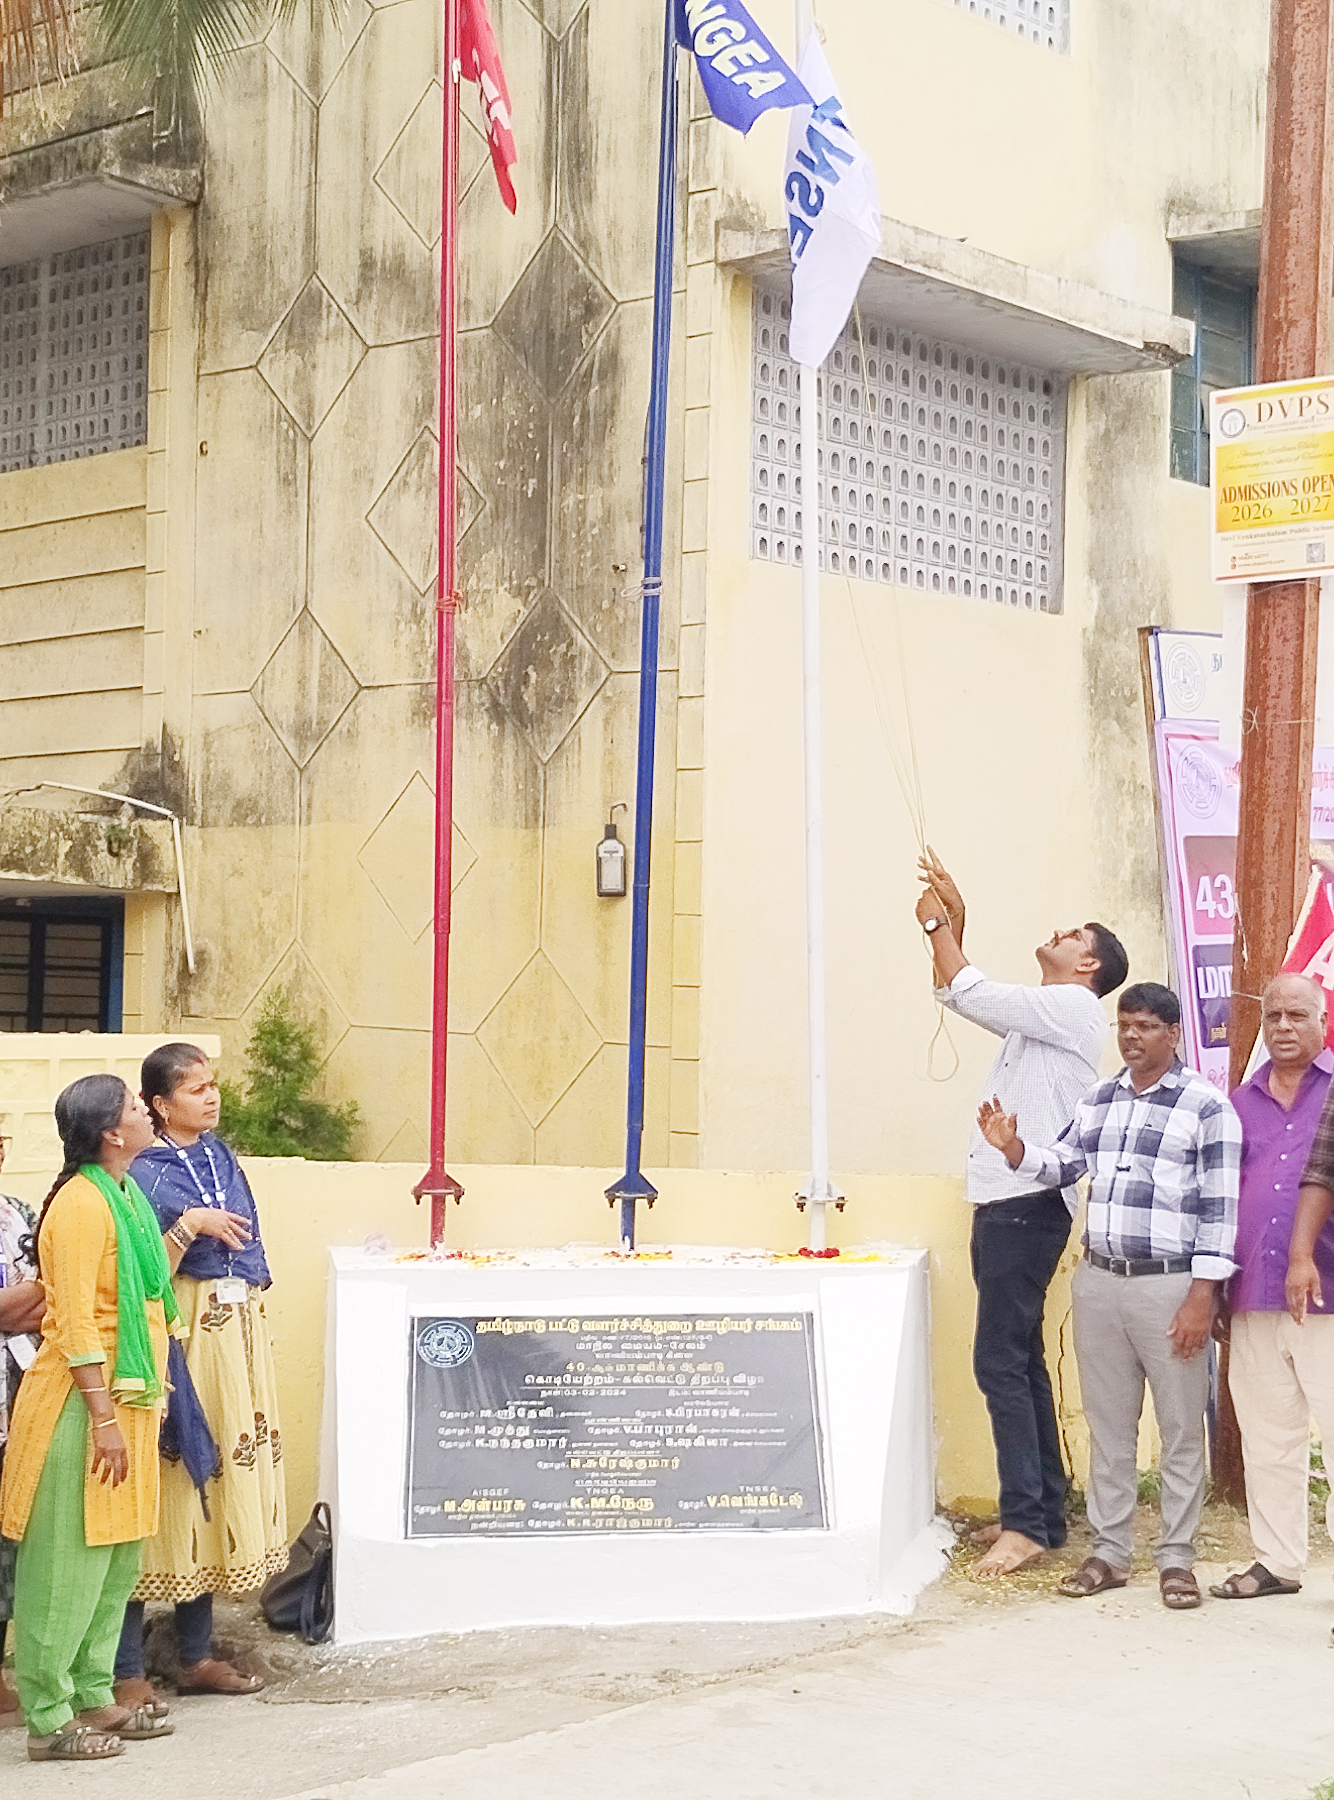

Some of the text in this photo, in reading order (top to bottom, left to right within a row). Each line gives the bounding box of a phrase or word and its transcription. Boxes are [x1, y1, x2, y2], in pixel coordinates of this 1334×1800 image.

[1257, 393, 1330, 423] DVPS
[1219, 478, 1298, 504] ADMISSIONS
[1231, 495, 1332, 522] 2026 2027
[476, 1316, 803, 1335] தமிழ்நாடு பட்டு வளர்ச்சித்துறை ஊழியர் சங்கம்
[575, 1341, 613, 1352] மாநில
[680, 1361, 725, 1373] ஆண்டு
[689, 1375, 729, 1388] திறப்பு
[732, 1375, 765, 1388] விழா
